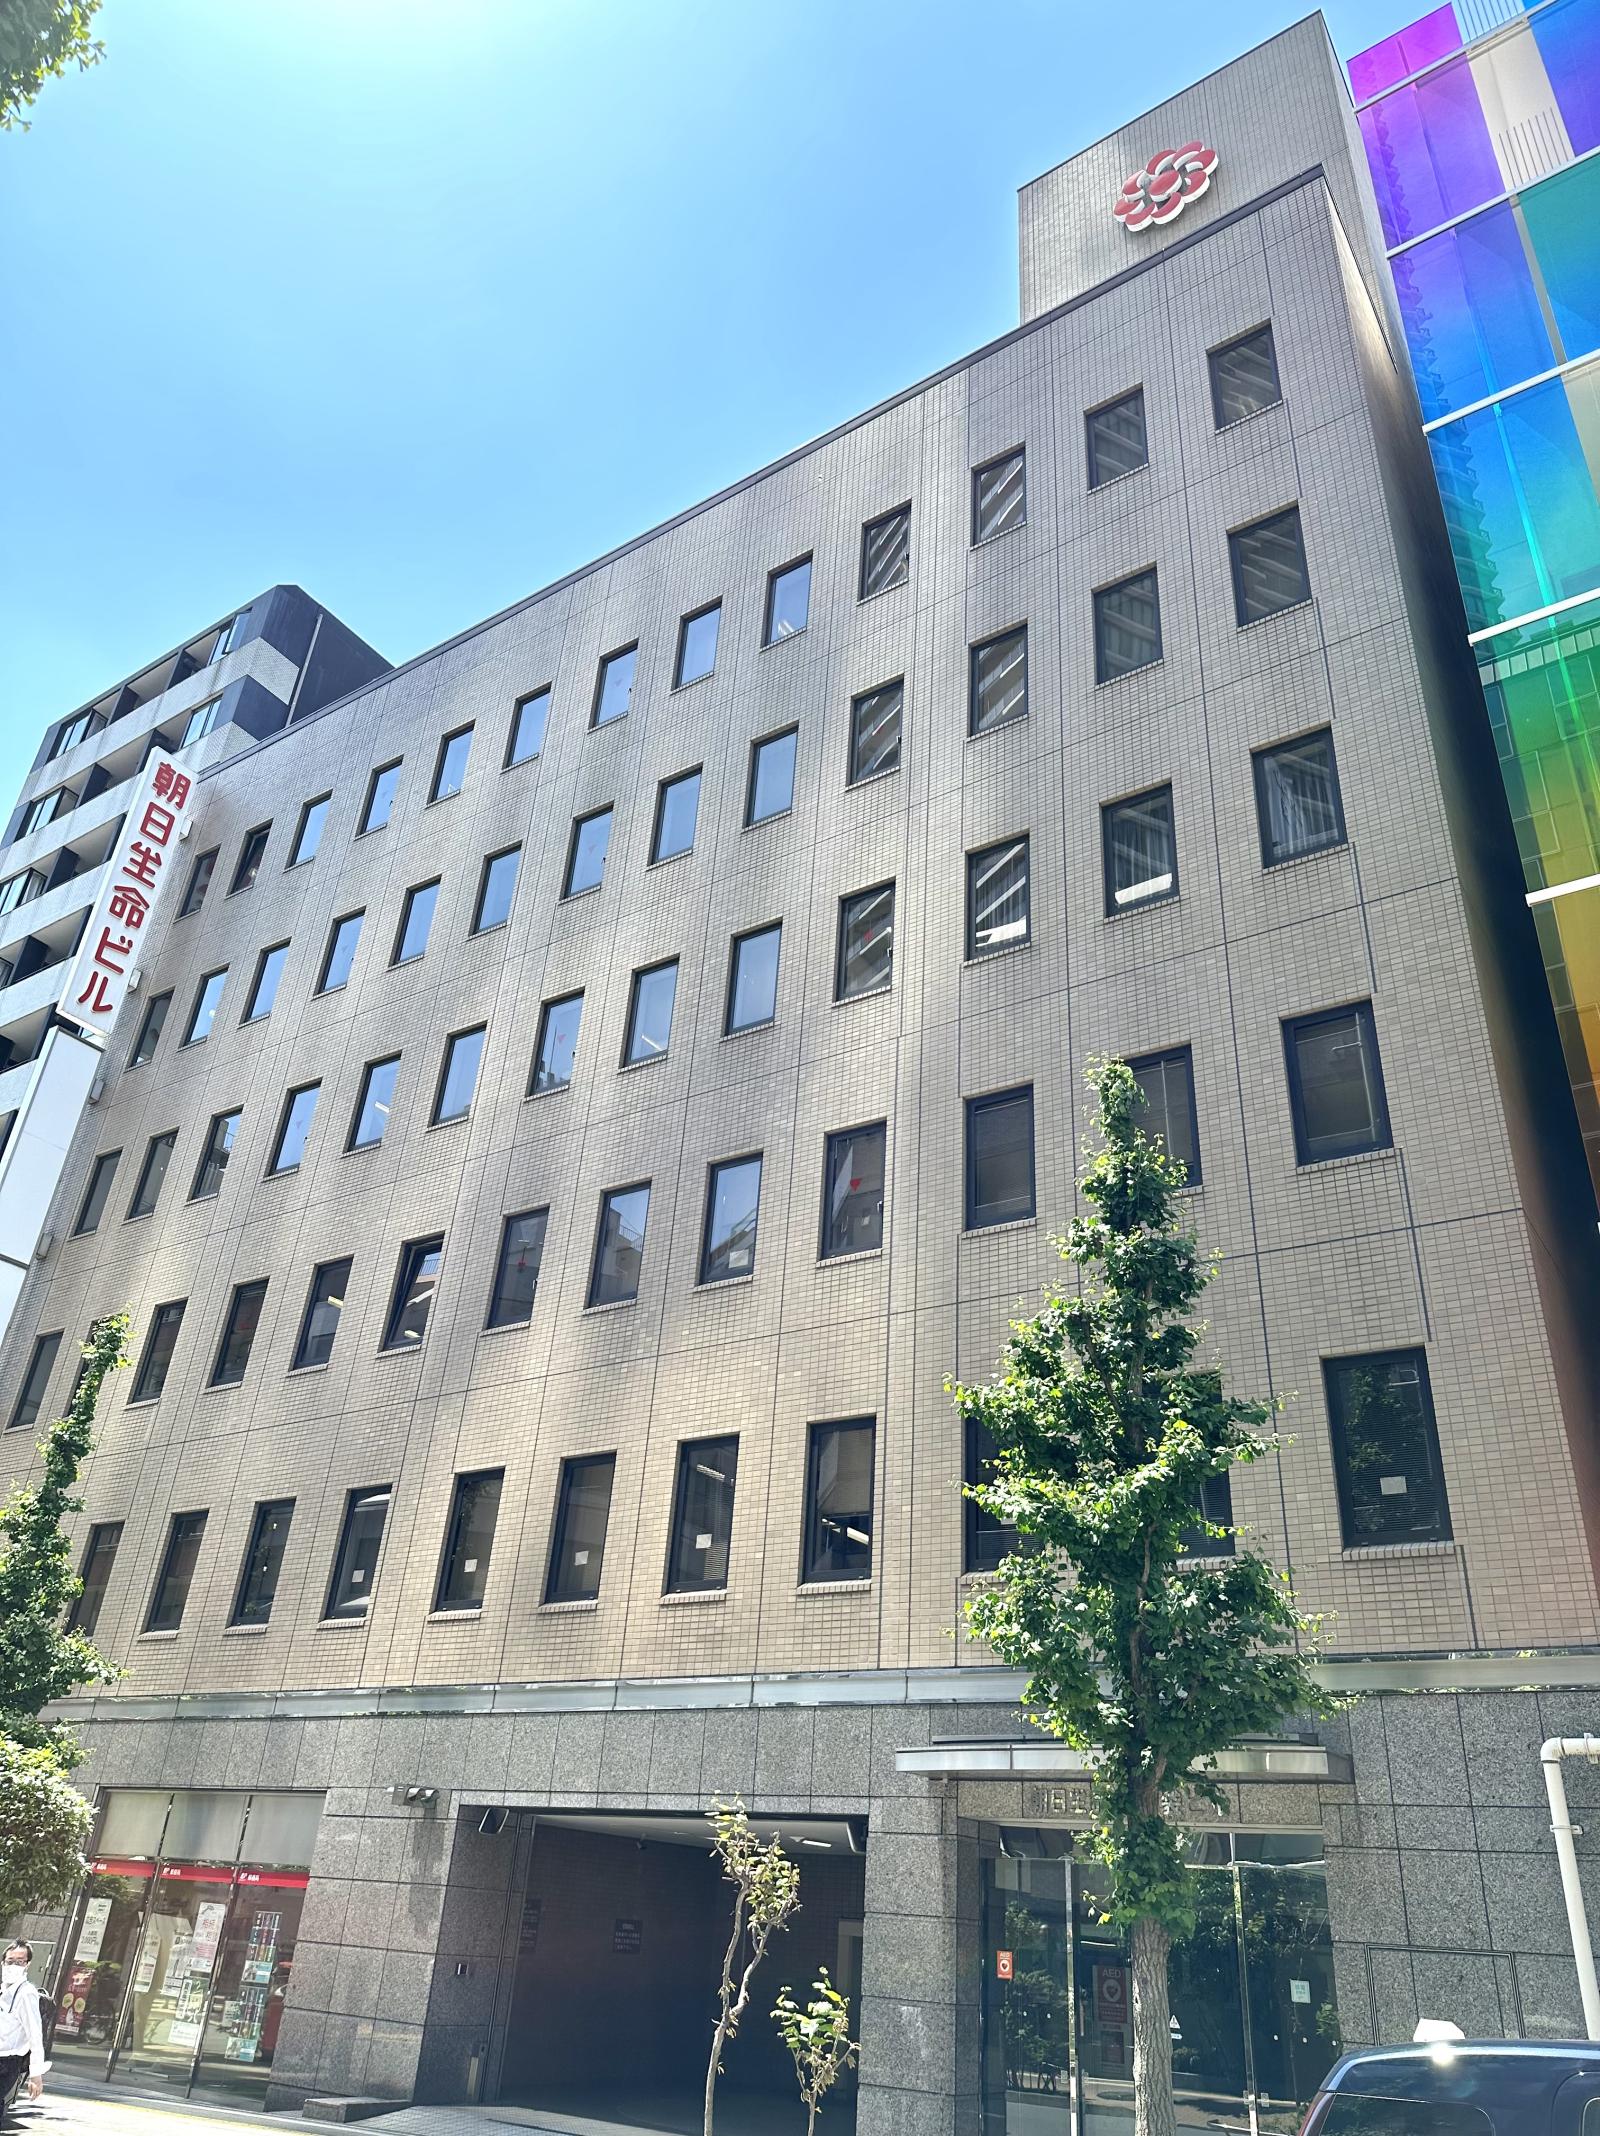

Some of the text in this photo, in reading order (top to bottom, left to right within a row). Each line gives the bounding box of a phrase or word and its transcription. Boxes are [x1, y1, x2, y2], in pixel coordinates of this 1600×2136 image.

[79, 761, 191, 1012] 朝日生命ビル
[1102, 1968, 1121, 1978] AED
